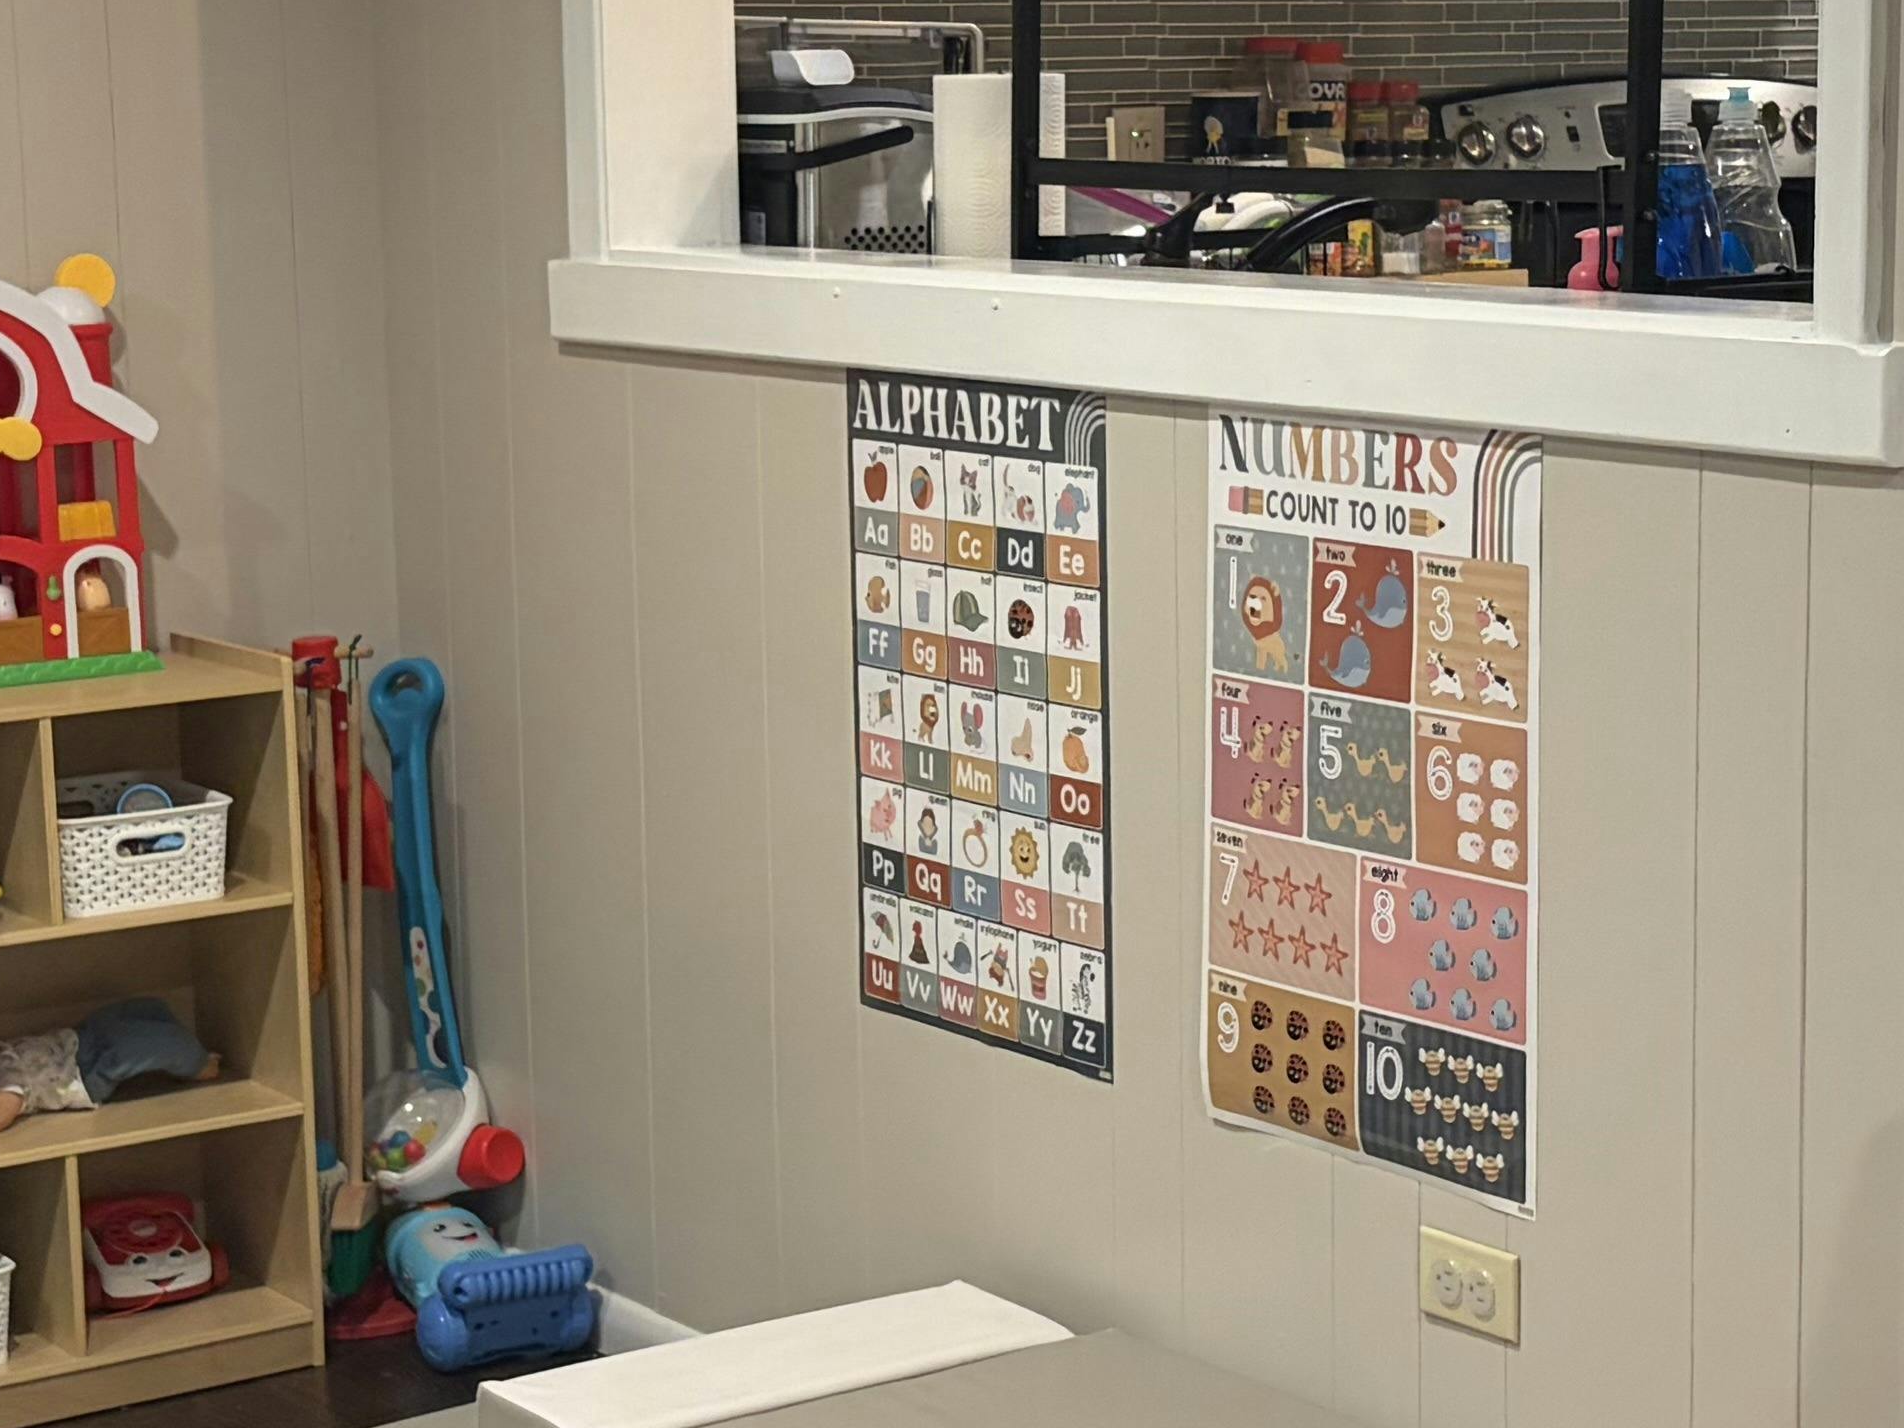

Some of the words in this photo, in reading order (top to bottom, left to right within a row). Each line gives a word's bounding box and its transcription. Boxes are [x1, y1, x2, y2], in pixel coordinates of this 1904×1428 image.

[852, 379, 1060, 451] ALPHABET
[1218, 414, 1458, 498] NUMBERS
[1266, 490, 1338, 526] COUNT
[1348, 501, 1376, 531] TO
[1385, 504, 1407, 535] 10
[864, 516, 889, 546] Aa
[910, 523, 933, 553] Bb
[958, 530, 982, 560] Cc
[1225, 534, 1243, 546] one
[1008, 538, 1033, 568] Dd
[1059, 545, 1085, 575] Ee
[1326, 546, 1346, 562] two
[1229, 556, 1237, 608] 1
[1426, 561, 1456, 578] three
[1322, 570, 1347, 625] 2
[1428, 585, 1454, 642] 3
[868, 628, 889, 657] Ff
[912, 637, 936, 673] Gg
[960, 646, 984, 677] Hh
[1066, 666, 1082, 701] Jj
[1220, 683, 1241, 698] four
[1320, 702, 1341, 718] five
[1219, 706, 1241, 759] 4
[1432, 723, 1447, 735] six
[870, 740, 893, 770] Kk
[1318, 725, 1343, 780] 5
[956, 760, 992, 794] Mm
[1009, 772, 1036, 804] Nn
[1426, 745, 1453, 801] 6
[1060, 784, 1090, 816] Oo
[872, 850, 895, 885] Pp
[915, 863, 942, 901] Qq
[1219, 853, 1239, 906] 7
[1371, 865, 1399, 882] eight
[964, 875, 986, 907] Rr
[1014, 888, 1037, 920] Ss
[1066, 902, 1088, 933] Tt
[1371, 889, 1396, 944] 8
[872, 961, 893, 991] Uu
[906, 971, 931, 1003] Vv
[940, 981, 974, 1017] Ww
[985, 995, 1010, 1029] Xx
[1026, 1008, 1053, 1046] Yy
[1072, 1021, 1096, 1054] Zz
[1216, 1002, 1240, 1054] 9
[1375, 1022, 1393, 1037] ten
[1366, 1041, 1404, 1101] 10
